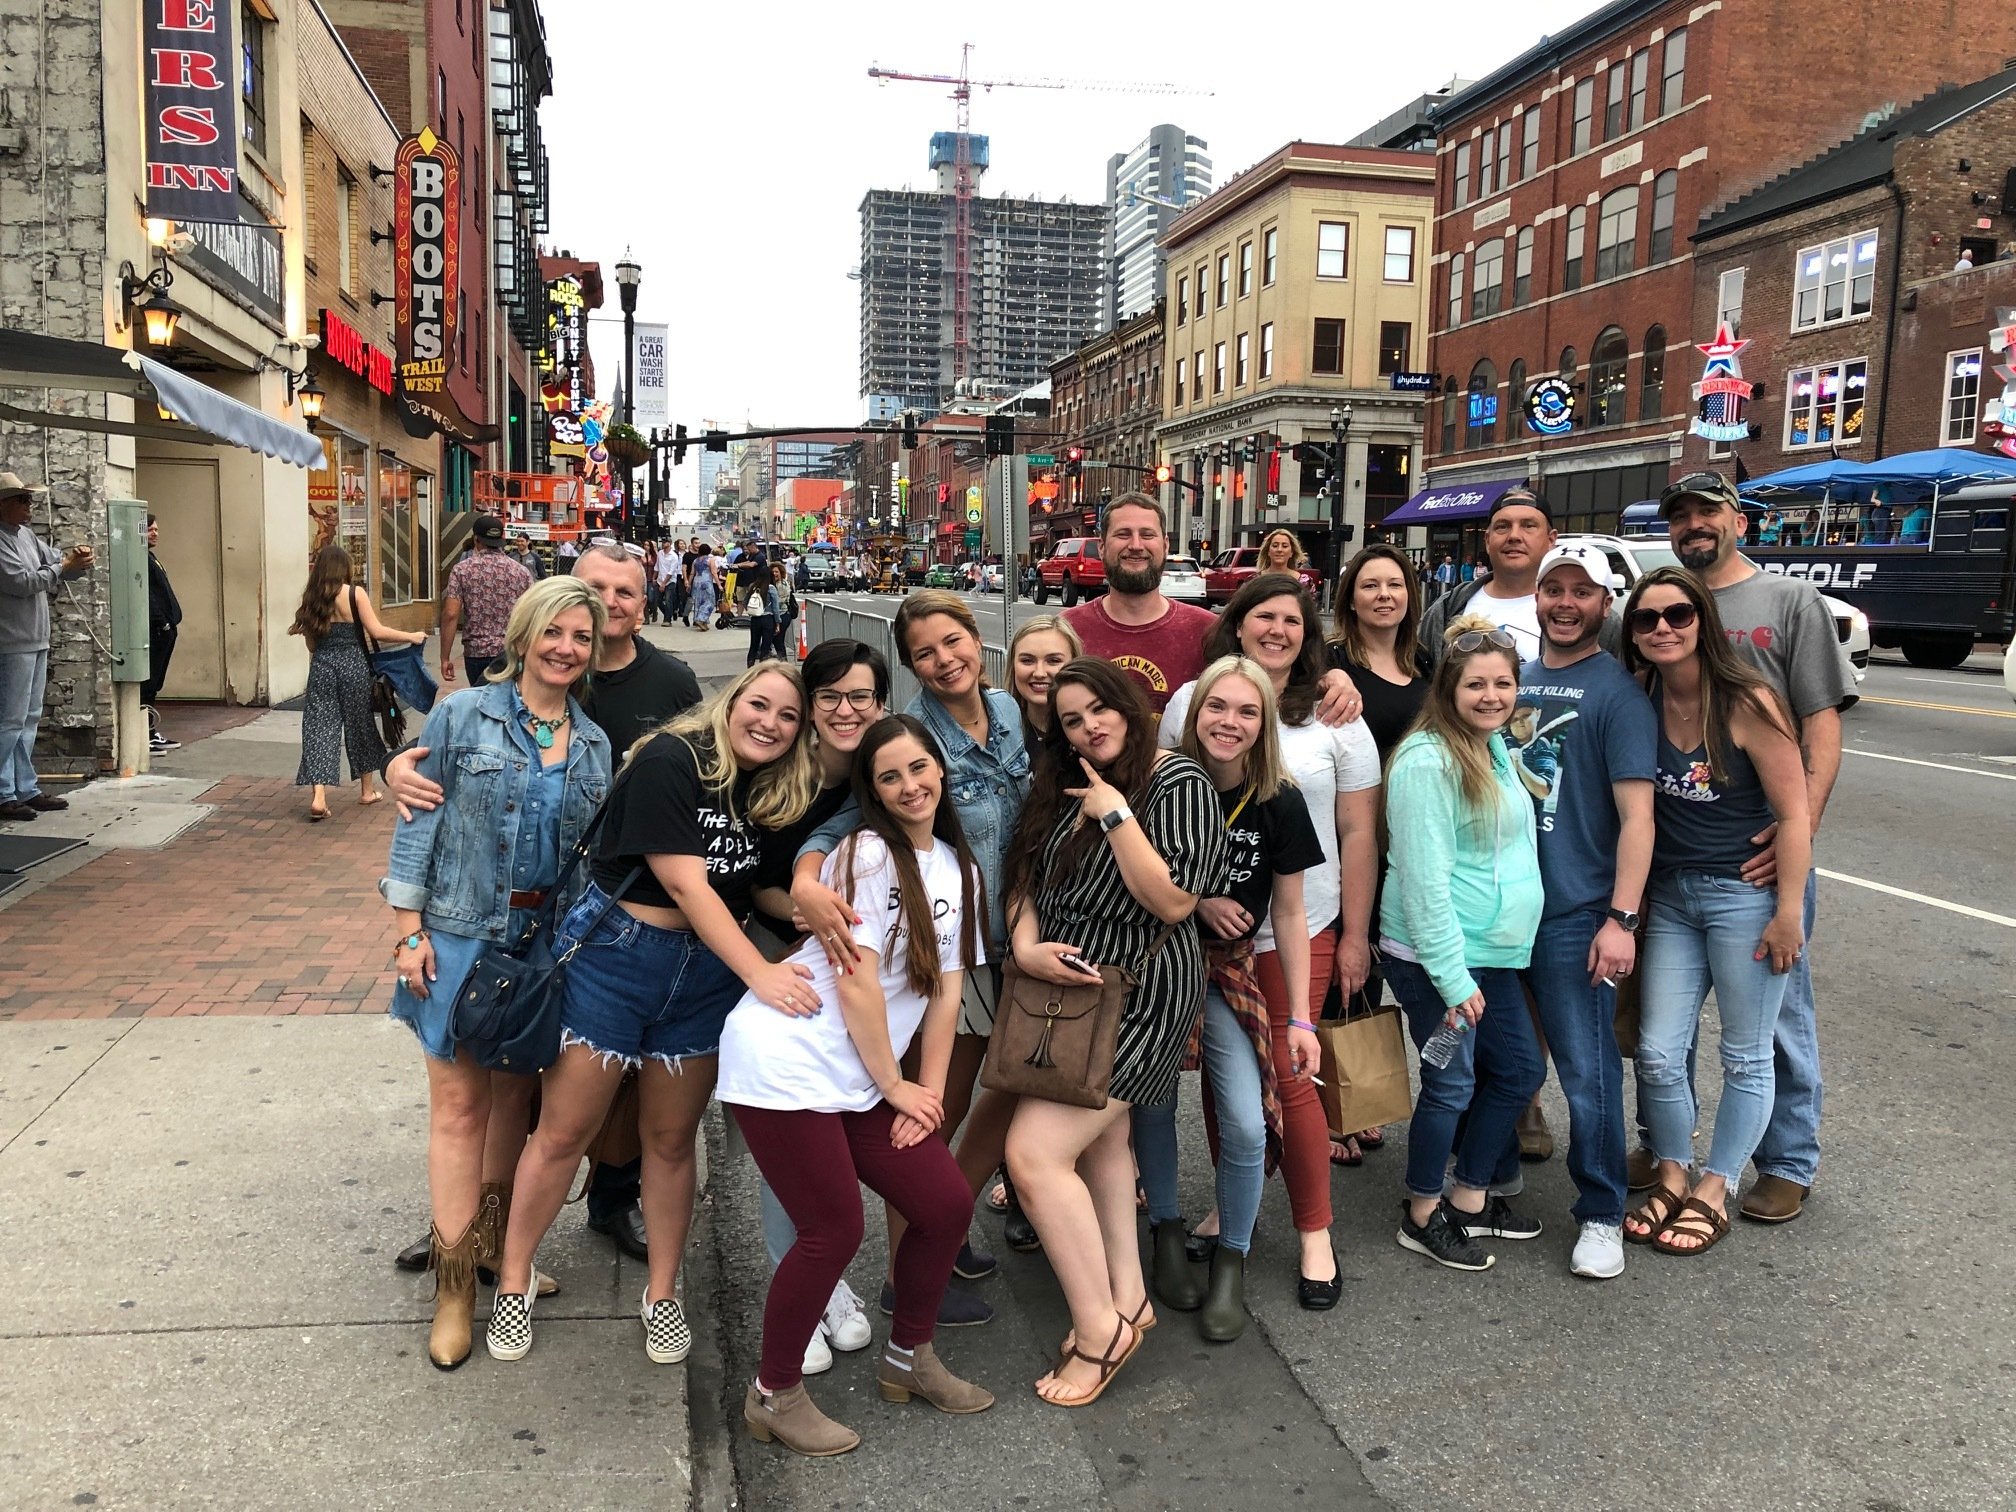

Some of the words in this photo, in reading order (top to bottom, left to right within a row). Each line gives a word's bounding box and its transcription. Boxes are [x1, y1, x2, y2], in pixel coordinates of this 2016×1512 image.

[147, 162, 234, 192] INN
[411, 161, 444, 360] BOOTS
[557, 280, 578, 294] KID
[550, 328, 568, 340] BIG
[570, 305, 580, 361] HONKY
[640, 335, 644, 343] A
[645, 336, 664, 344] GREAT
[326, 309, 363, 377] BOOTS
[639, 343, 664, 358] CAR
[401, 358, 446, 376] TRAIL
[640, 358, 663, 368] WASH
[640, 367, 664, 376] STARTS
[404, 376, 443, 392] WEST
[571, 367, 581, 411] TONK
[639, 376, 664, 388] HERE
[1702, 379, 1750, 395] REDNECK
[1470, 396, 1497, 418] NASH
[1182, 429, 1206, 442] BROADWAY
[1208, 421, 1234, 434] NATIONAL
[1237, 416, 1253, 428] BANK
[891, 461, 900, 504] WHISKEY
[309, 488, 338, 497] OOT
[1449, 491, 1484, 507] Office
[891, 505, 899, 527] ROW
[1141, 661, 1165, 687] MADE
[1515, 685, 1543, 697] OU'RE
[1542, 685, 1585, 699] KILLING
[706, 856, 730, 874] ETS
